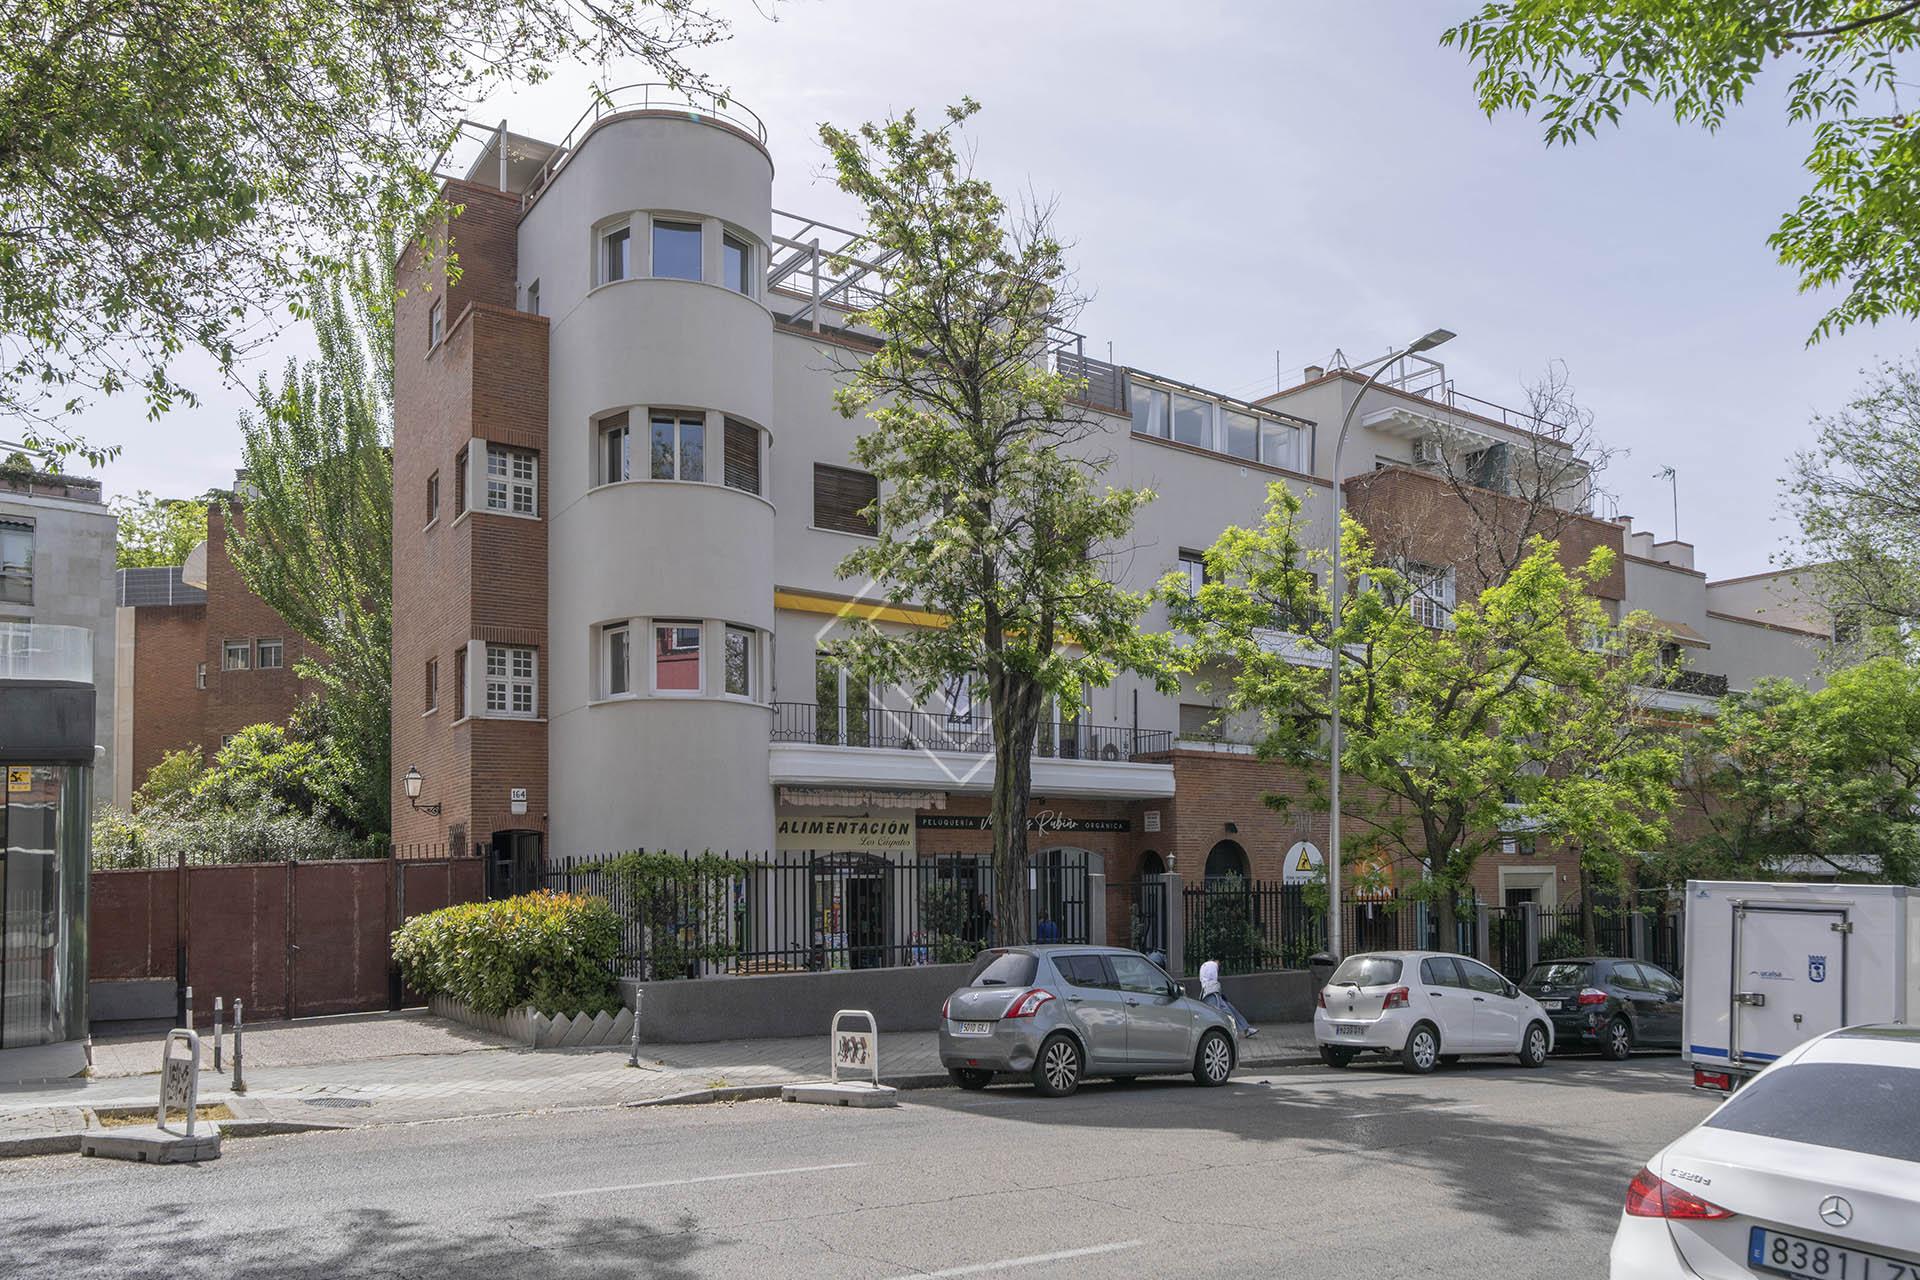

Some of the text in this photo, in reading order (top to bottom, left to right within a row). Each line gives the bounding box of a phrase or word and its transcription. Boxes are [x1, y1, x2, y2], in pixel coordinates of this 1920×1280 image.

[512, 790, 525, 798] 164
[778, 820, 910, 835] ALIMENTACIÓN
[1772, 1237, 1847, 1280] 8381
